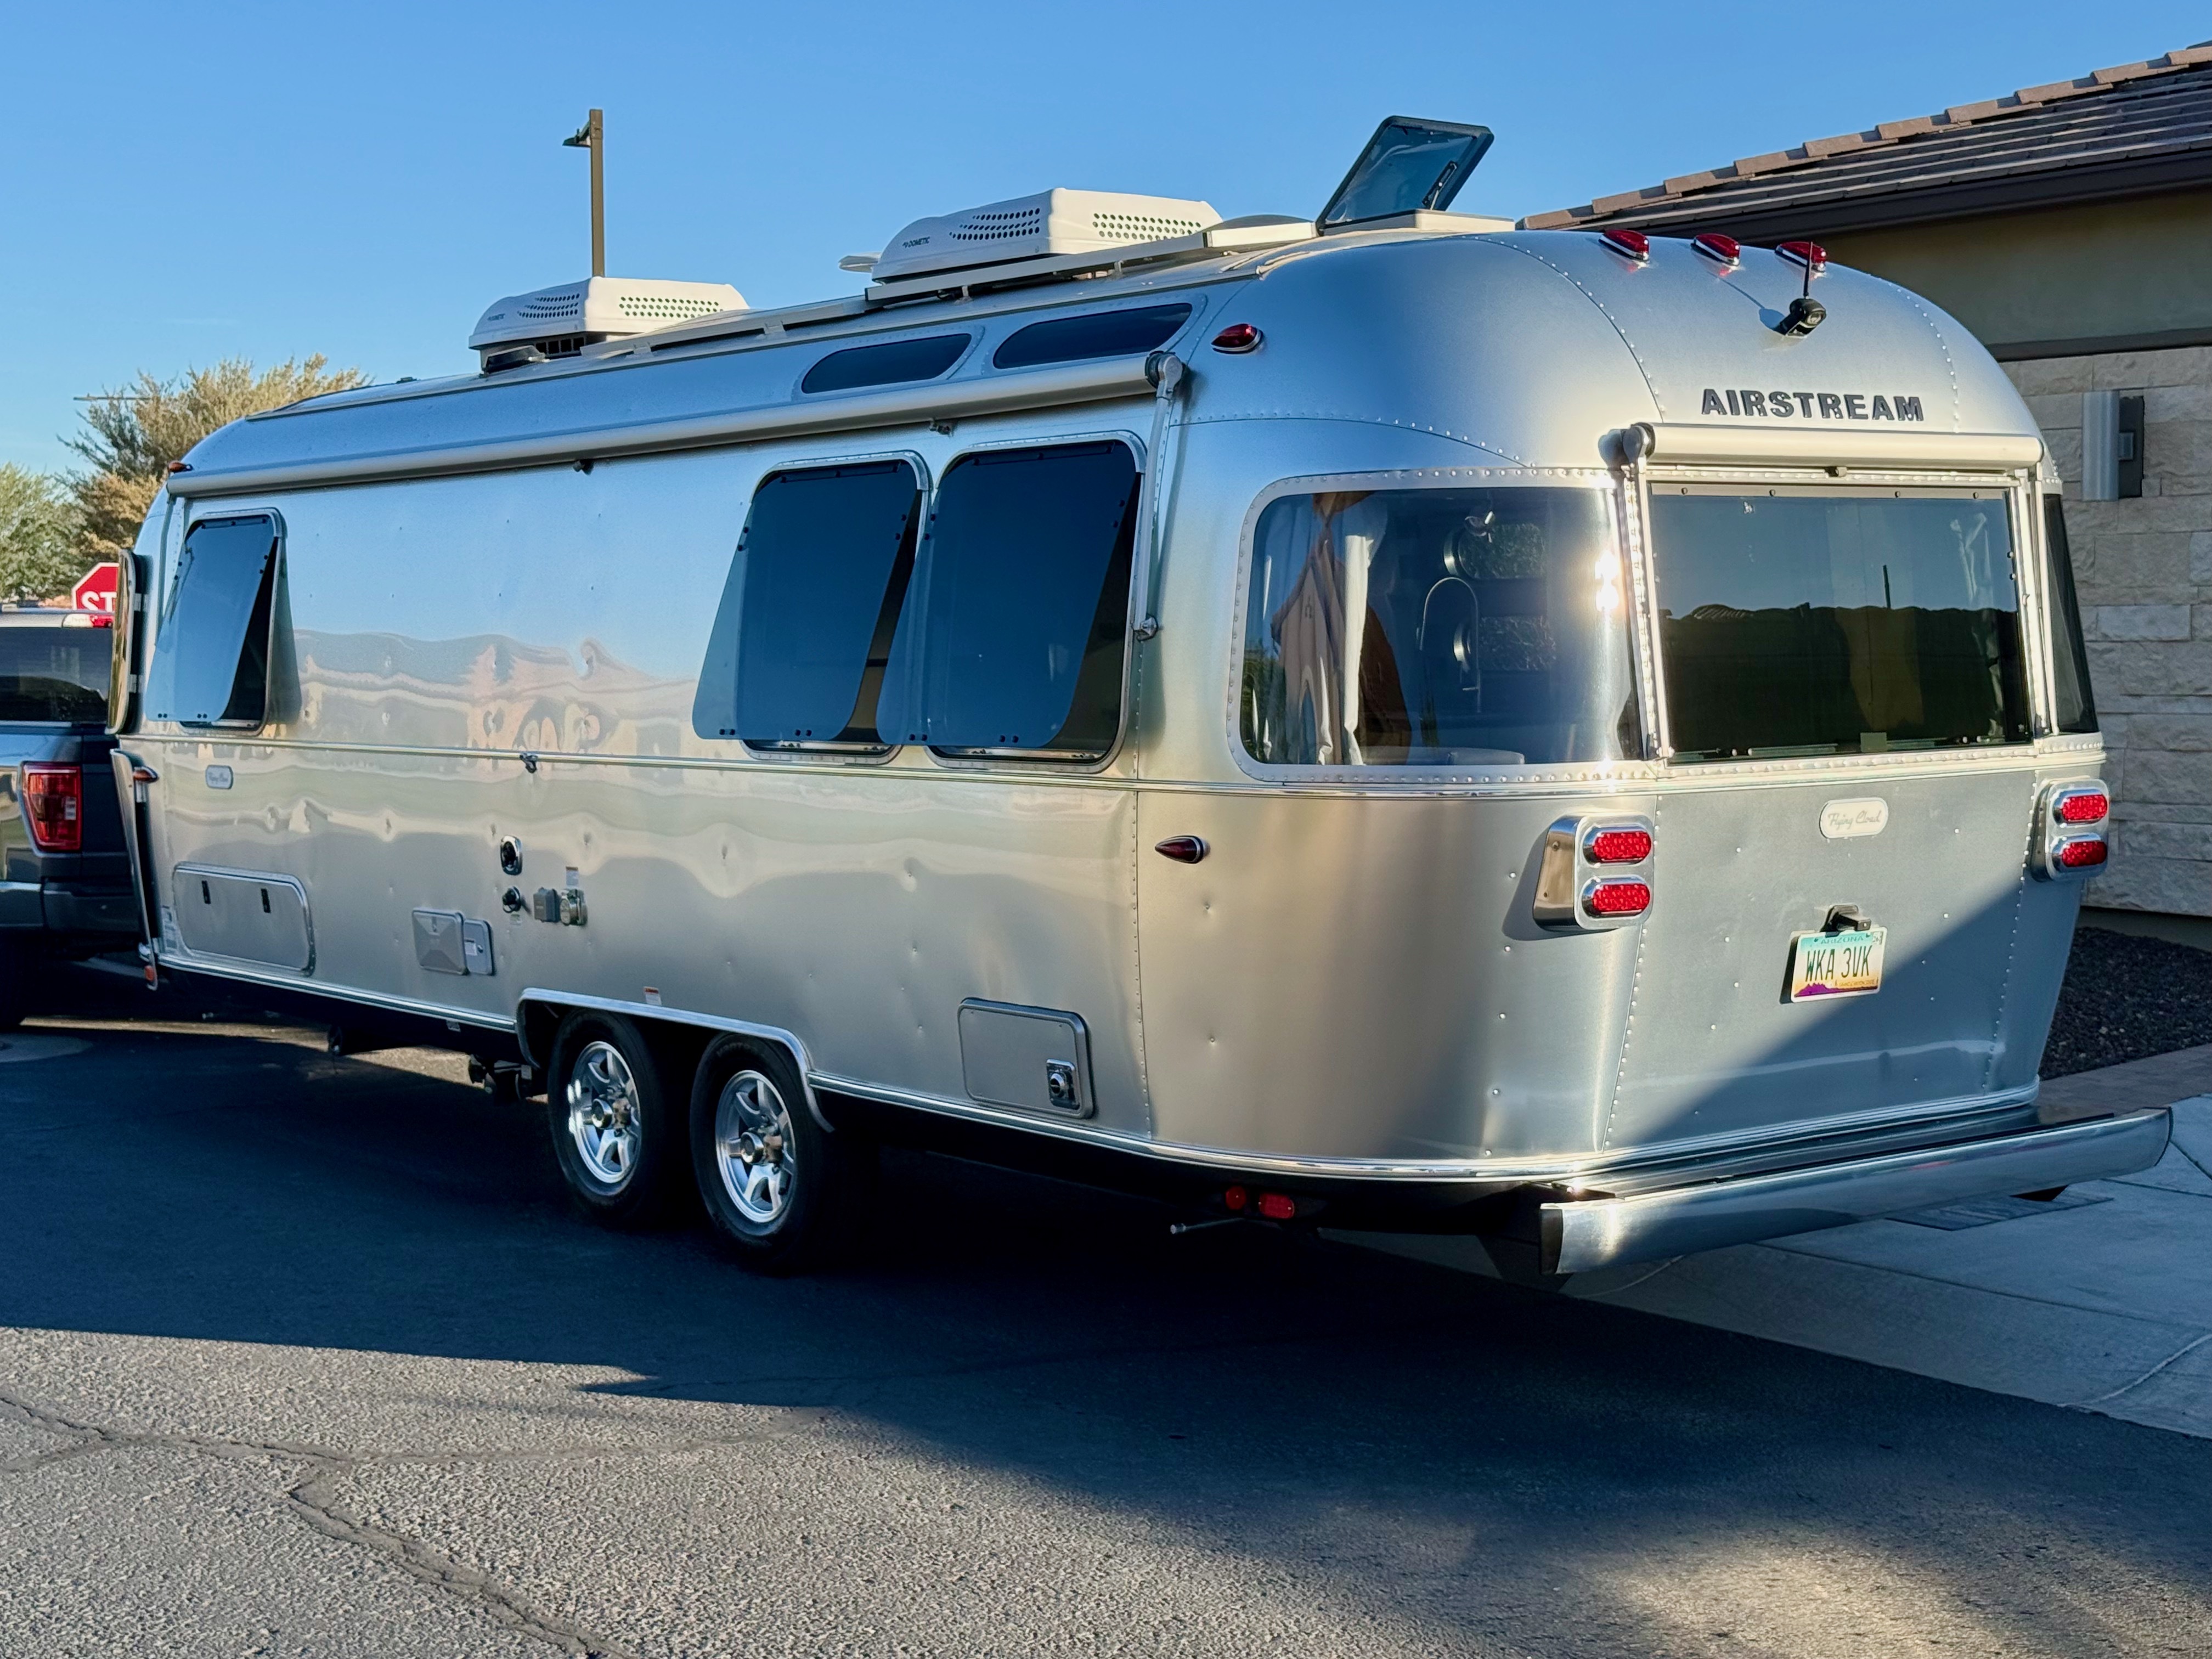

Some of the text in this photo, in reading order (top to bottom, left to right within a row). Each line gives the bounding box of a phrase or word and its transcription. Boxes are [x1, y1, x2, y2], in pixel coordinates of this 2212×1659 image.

[1701, 388, 1924, 421] AIRSTREAM
[82, 591, 117, 612] ST
[1828, 810, 1882, 831] Flying Cloud
[1821, 935, 1864, 944] ARIZONA
[1805, 945, 1873, 982] WKA 3VK
